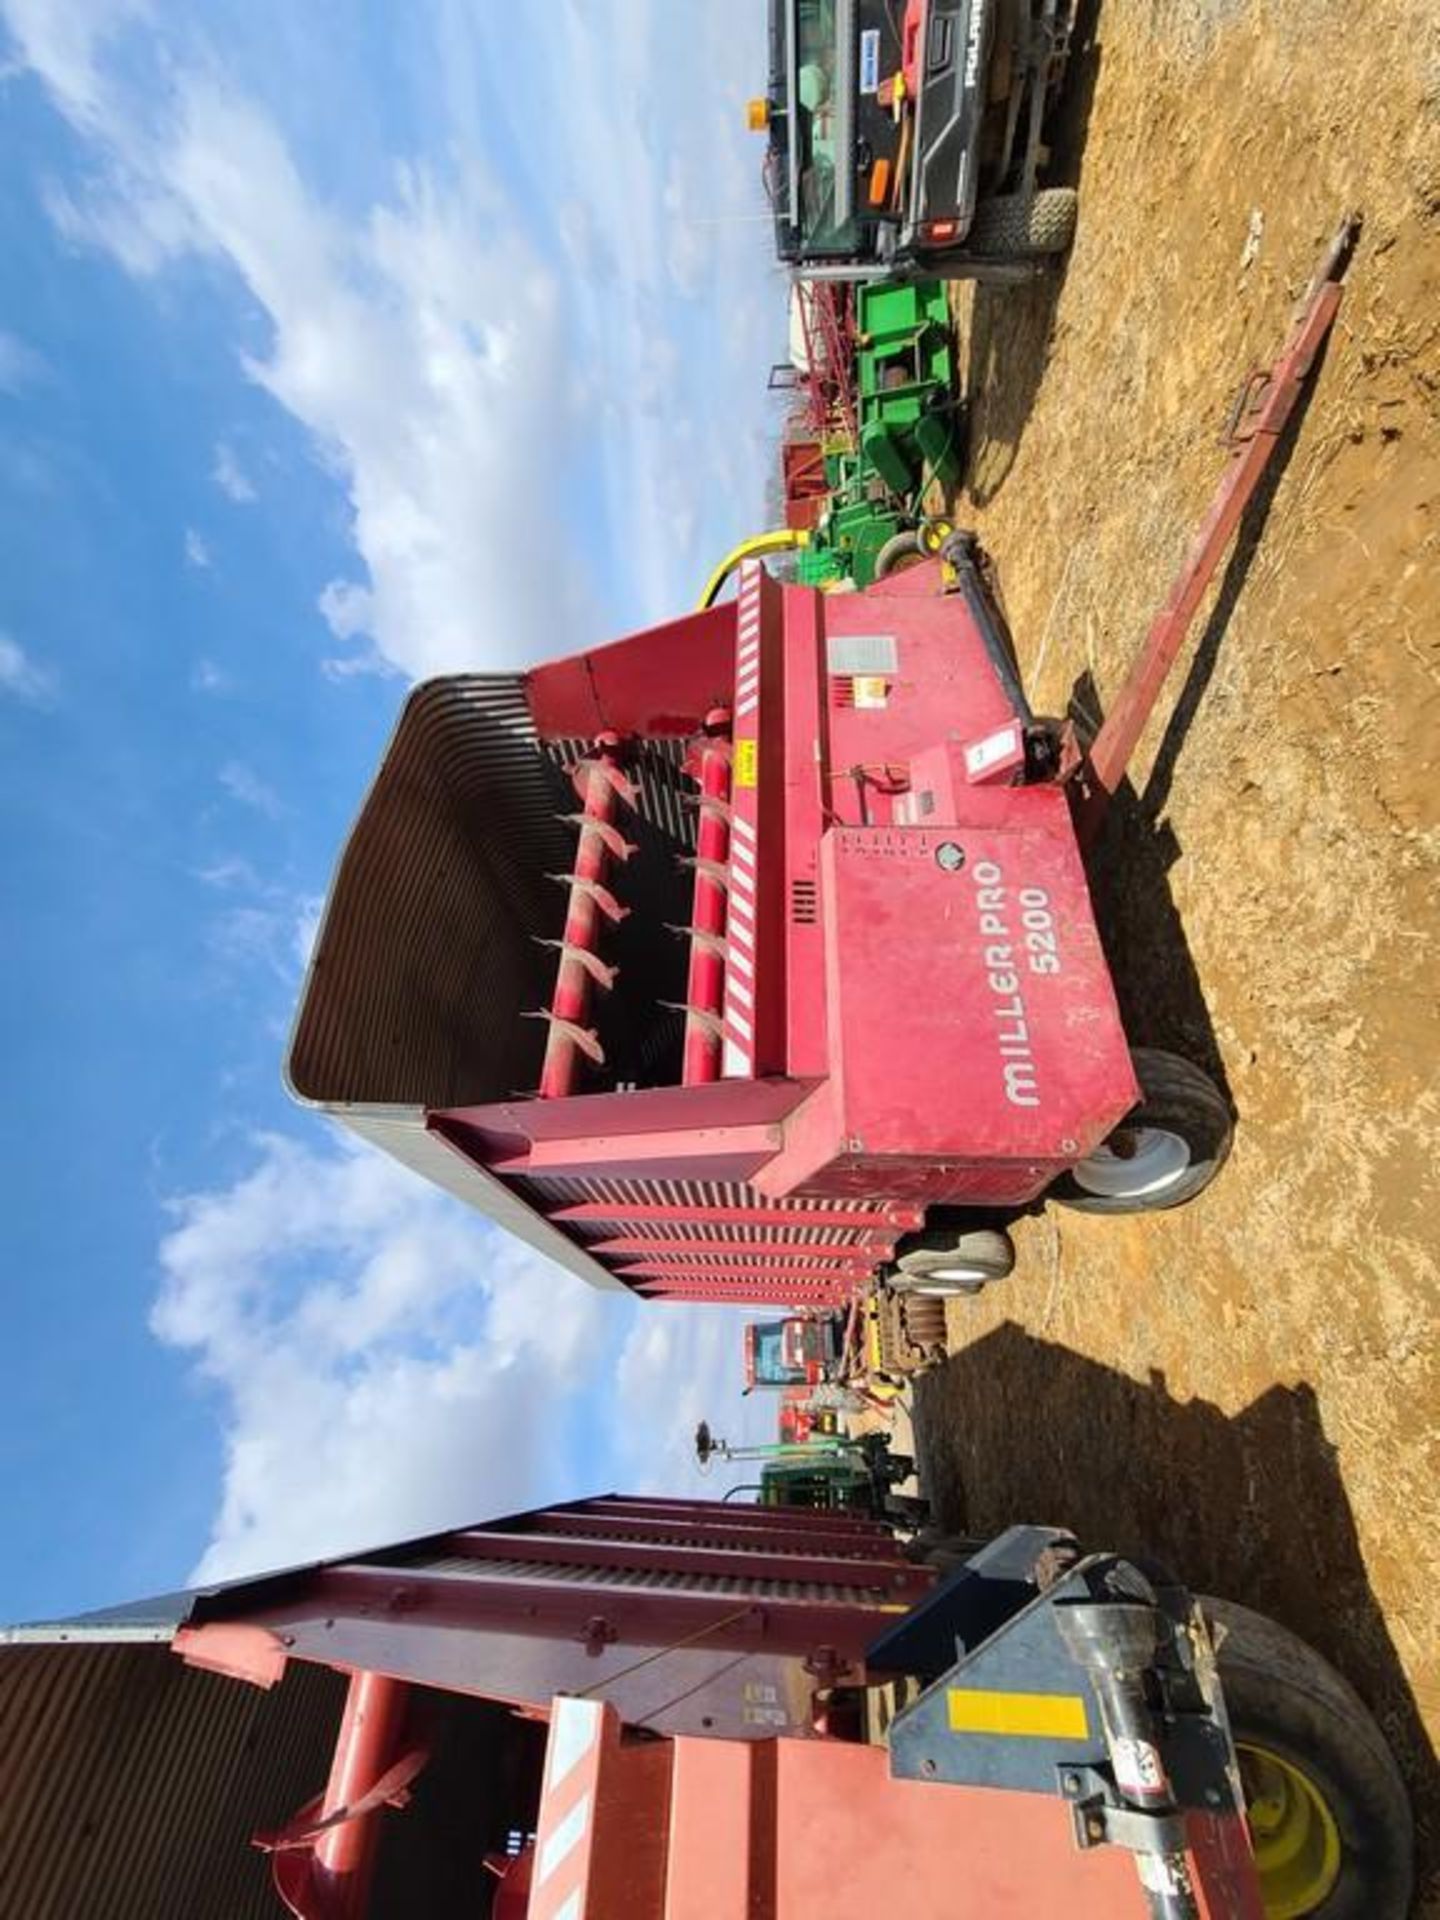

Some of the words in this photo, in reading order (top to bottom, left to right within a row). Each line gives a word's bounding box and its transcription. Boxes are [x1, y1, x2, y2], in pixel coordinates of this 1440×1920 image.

[972, 861, 1009, 935] PRO
[1019, 888, 1061, 974] 5200
[984, 944, 1040, 1106] MILLER
